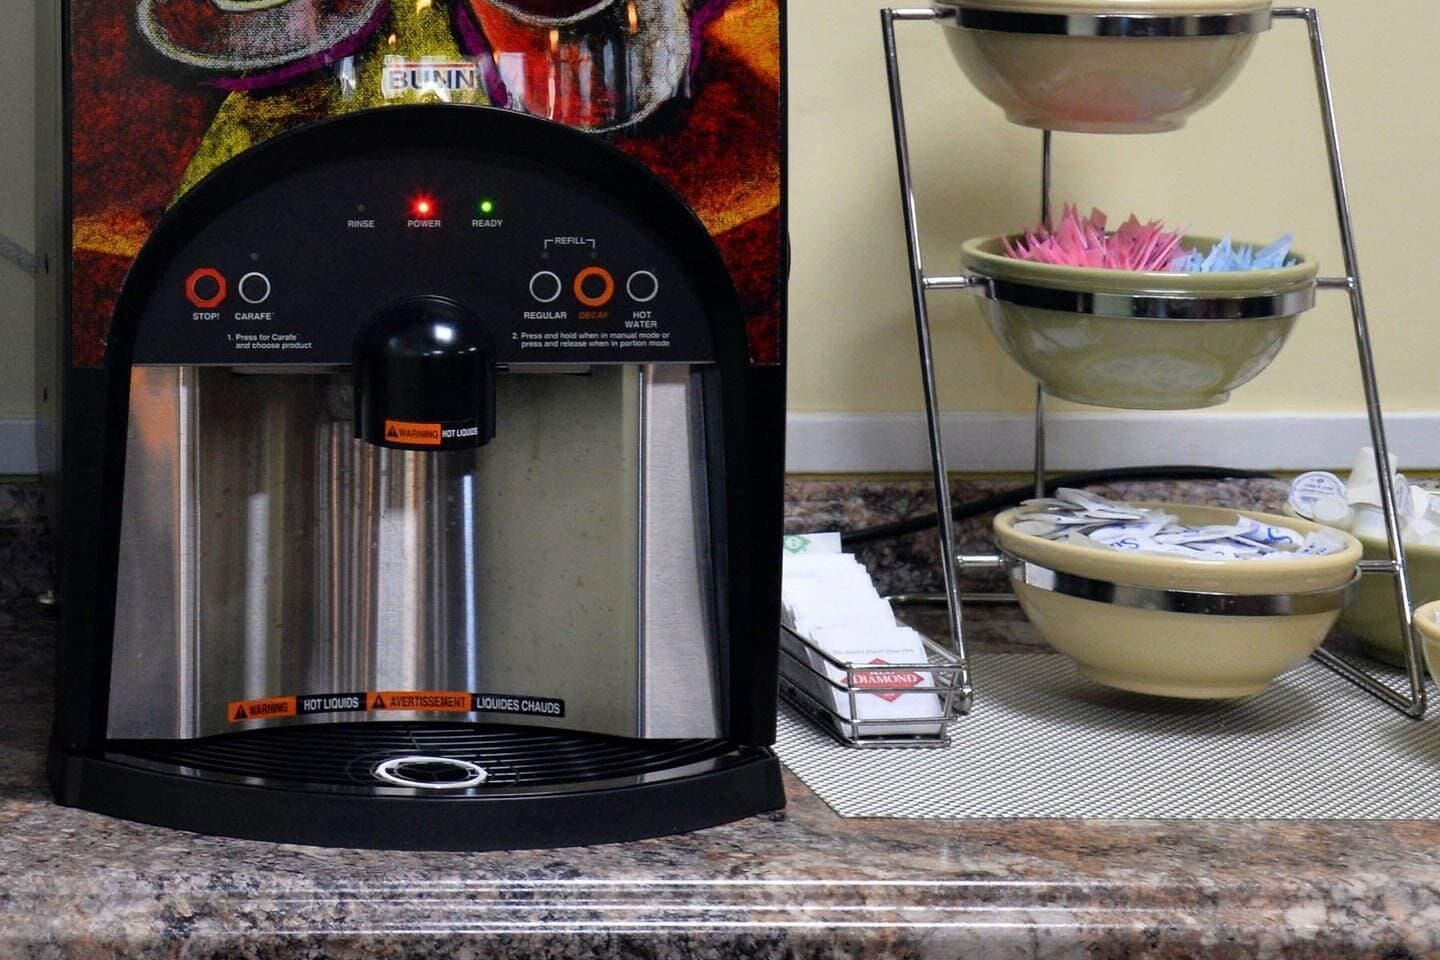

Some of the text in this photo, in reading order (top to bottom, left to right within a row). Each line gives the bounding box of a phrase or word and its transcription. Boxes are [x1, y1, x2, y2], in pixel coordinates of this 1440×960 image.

[389, 70, 475, 90] BUNN
[347, 219, 375, 228] RINSE
[407, 219, 441, 228] POWER
[472, 219, 503, 228] READY
[554, 236, 586, 245] REFILL
[192, 312, 220, 320] STOP!
[523, 311, 568, 319] REGULAR
[578, 311, 609, 320] DECAF
[632, 310, 653, 319] HOT
[624, 320, 658, 328] WATER
[235, 333, 258, 341] Press
[259, 333, 270, 341] for
[521, 331, 543, 340] Press
[544, 332, 559, 340] and
[578, 332, 599, 340] when
[609, 332, 637, 340] manual
[638, 332, 661, 340] mode
[235, 342, 312, 351] and choose product
[521, 341, 543, 350] press
[400, 428, 438, 439] WARNING
[442, 429, 455, 438] HOT
[853, 673, 917, 685] DIAMOND
[249, 696, 561, 715] WARNING HOT LIQUIDS AVERTISSEMENT LIQUIDES CHAUDS
